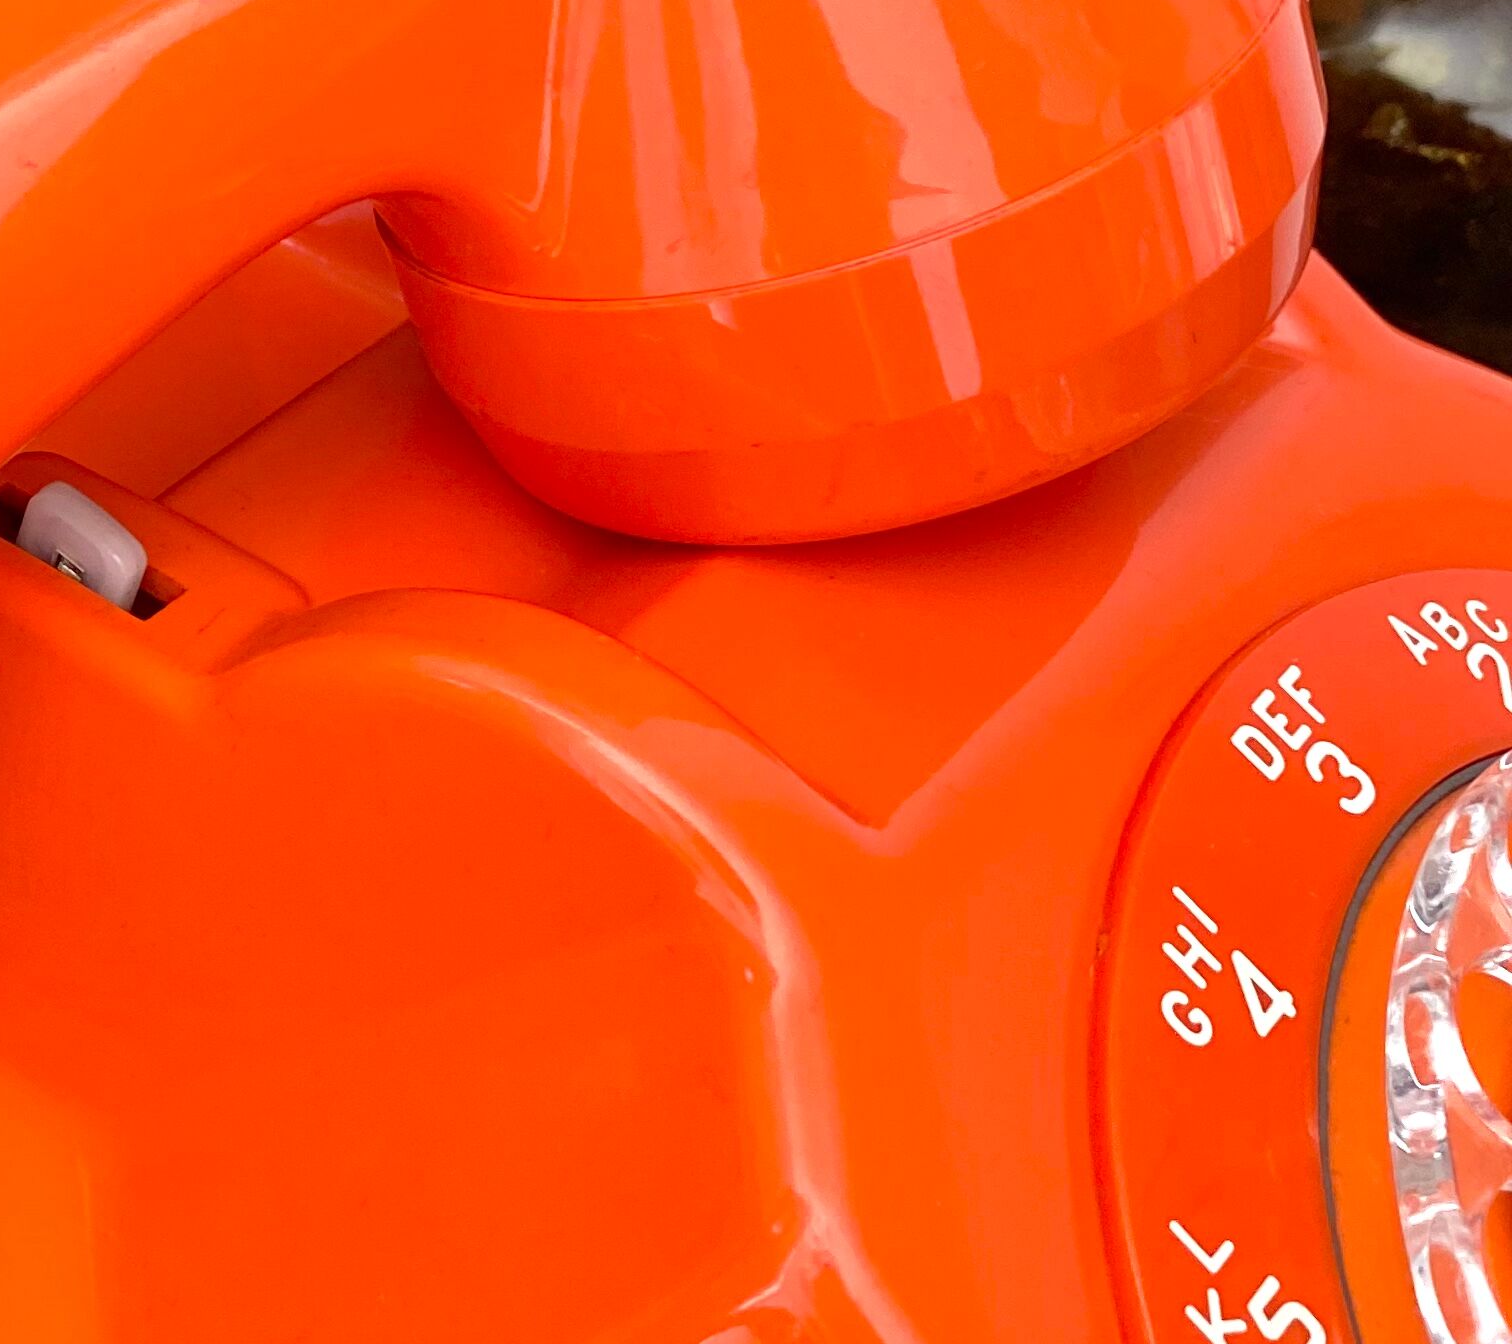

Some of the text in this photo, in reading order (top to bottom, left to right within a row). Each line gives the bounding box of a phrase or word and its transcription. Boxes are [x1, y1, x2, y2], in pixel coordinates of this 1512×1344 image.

[1388, 599, 1509, 667] ABC
[1466, 641, 1512, 715] 2
[1230, 664, 1326, 781] DEF
[1304, 741, 1376, 815] 3
[1161, 886, 1223, 1047] GHI
[1231, 949, 1297, 1038] 4
